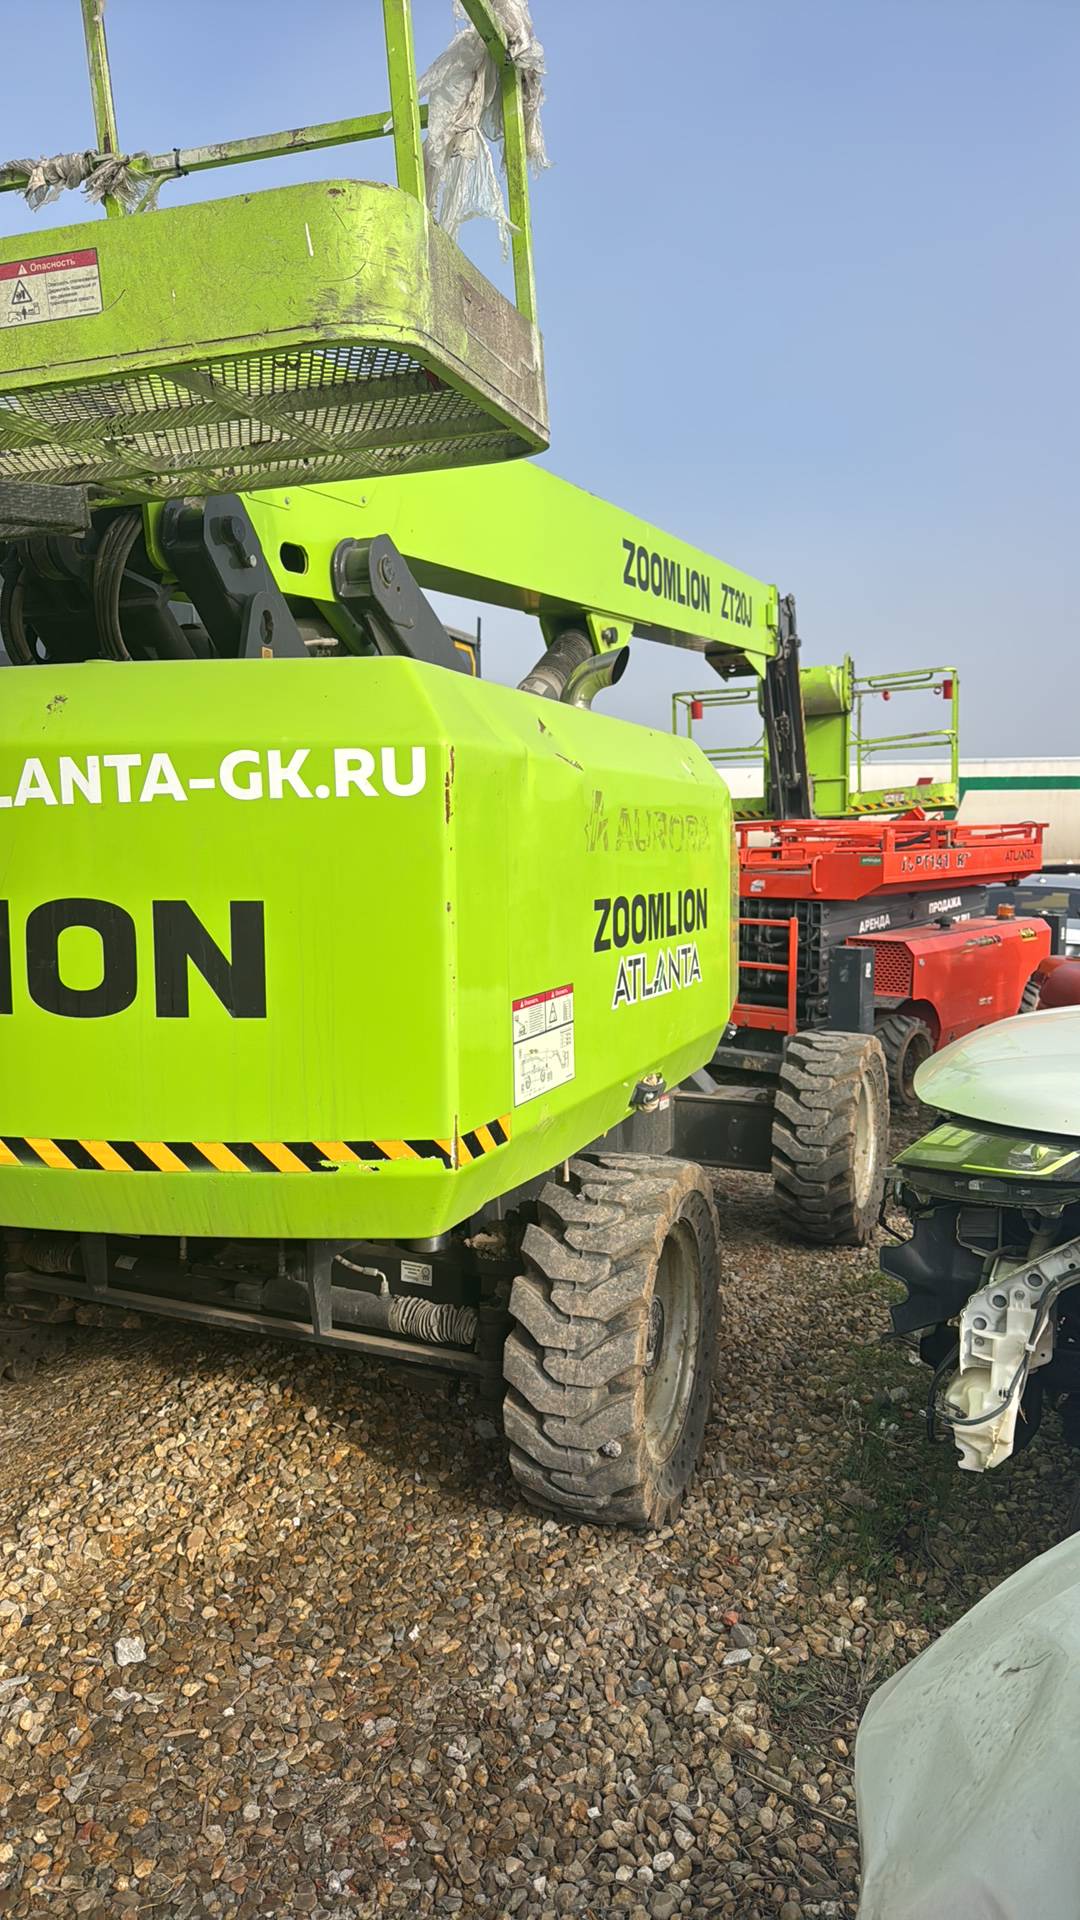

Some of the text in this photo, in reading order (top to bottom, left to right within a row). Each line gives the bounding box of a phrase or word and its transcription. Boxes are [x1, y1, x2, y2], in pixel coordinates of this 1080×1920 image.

[30, 258, 76, 272] Опасность
[622, 537, 753, 628] ZOOMLION ZT20J
[1004, 849, 1034, 862] ATLANTA
[928, 895, 962, 914] ПРОДАЖА
[593, 887, 708, 953] ZOOMLION
[859, 913, 891, 934] АРЕНДА
[613, 945, 702, 1007] ATLANTA
